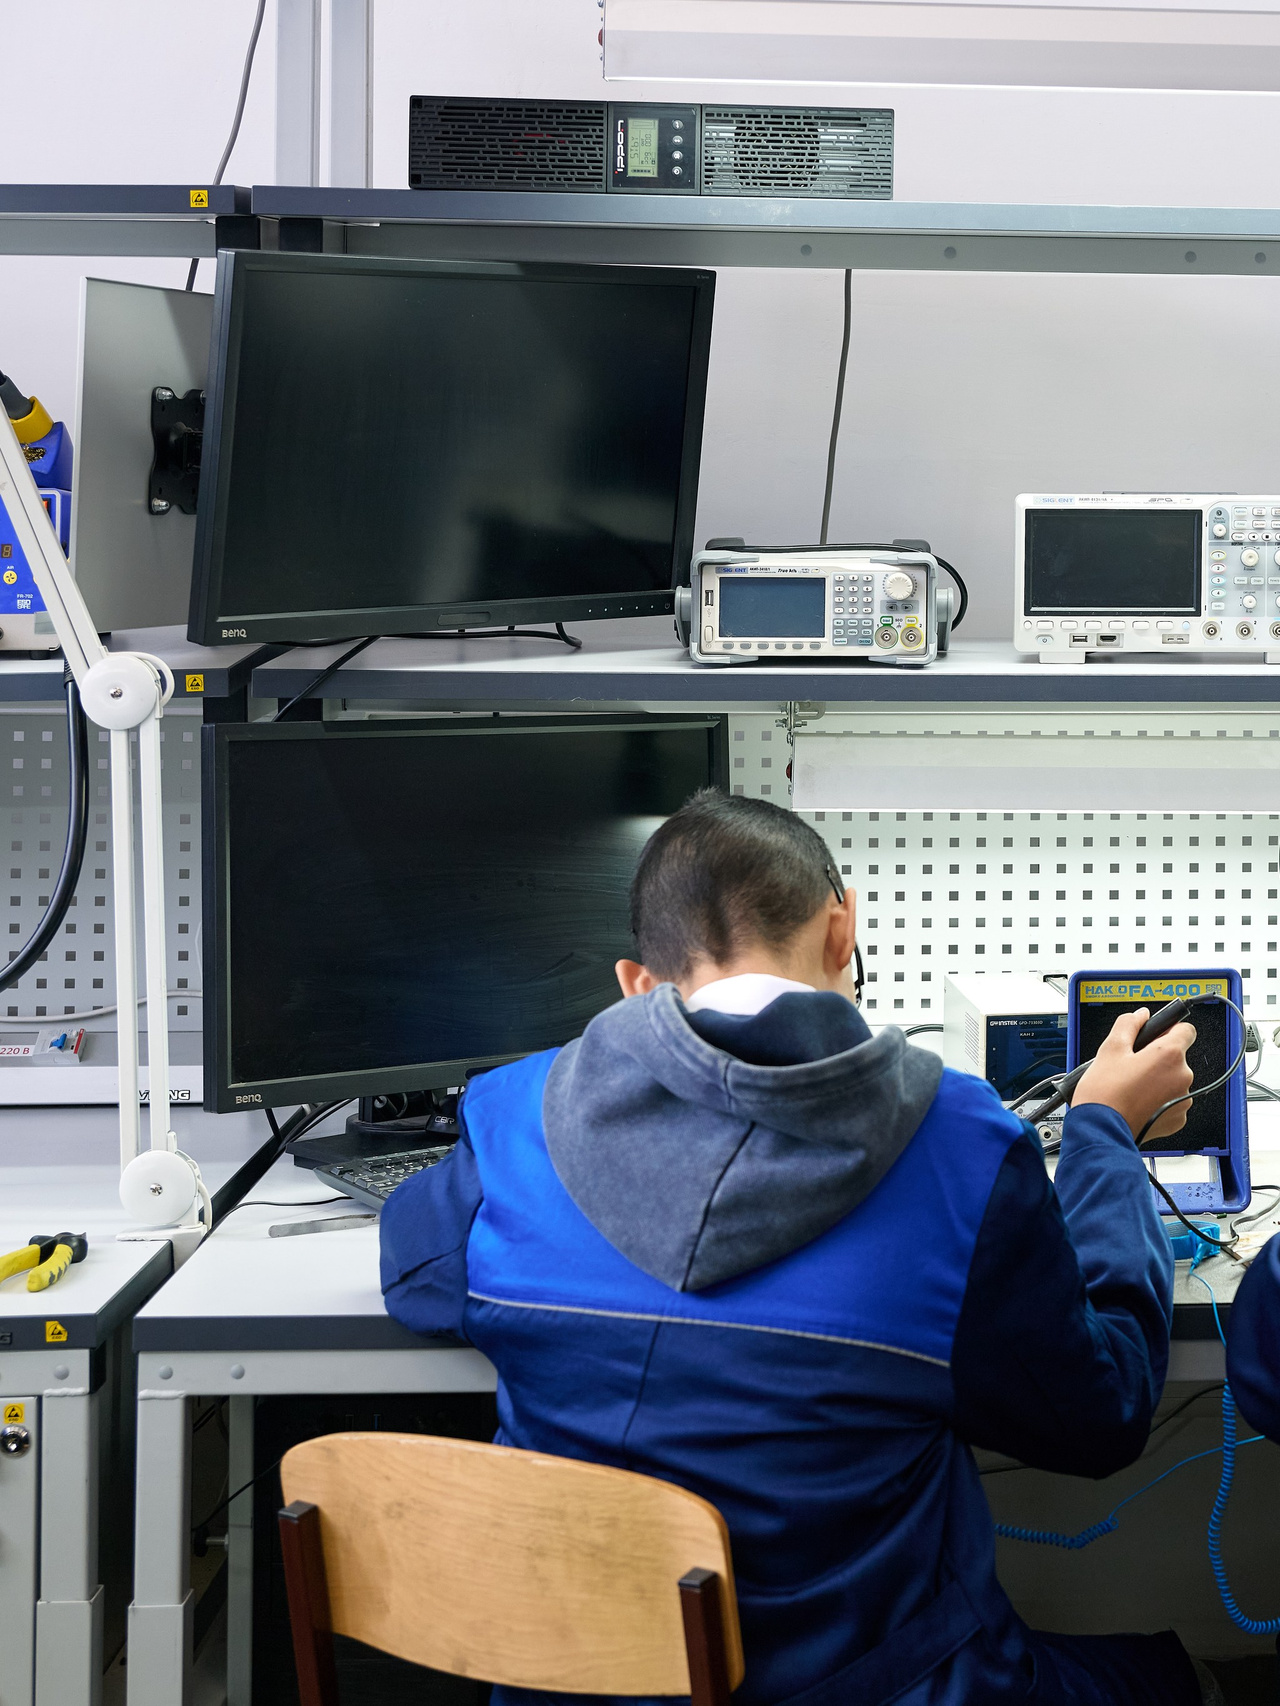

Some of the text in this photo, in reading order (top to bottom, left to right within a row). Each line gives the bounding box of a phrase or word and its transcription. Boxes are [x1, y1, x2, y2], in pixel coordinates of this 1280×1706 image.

[614, 120, 625, 174] ippon
[221, 628, 247, 638] BenQ
[1128, 983, 1201, 997] FA-400
[0, 1047, 20, 1055] 220
[235, 1093, 263, 1104] BenQ
